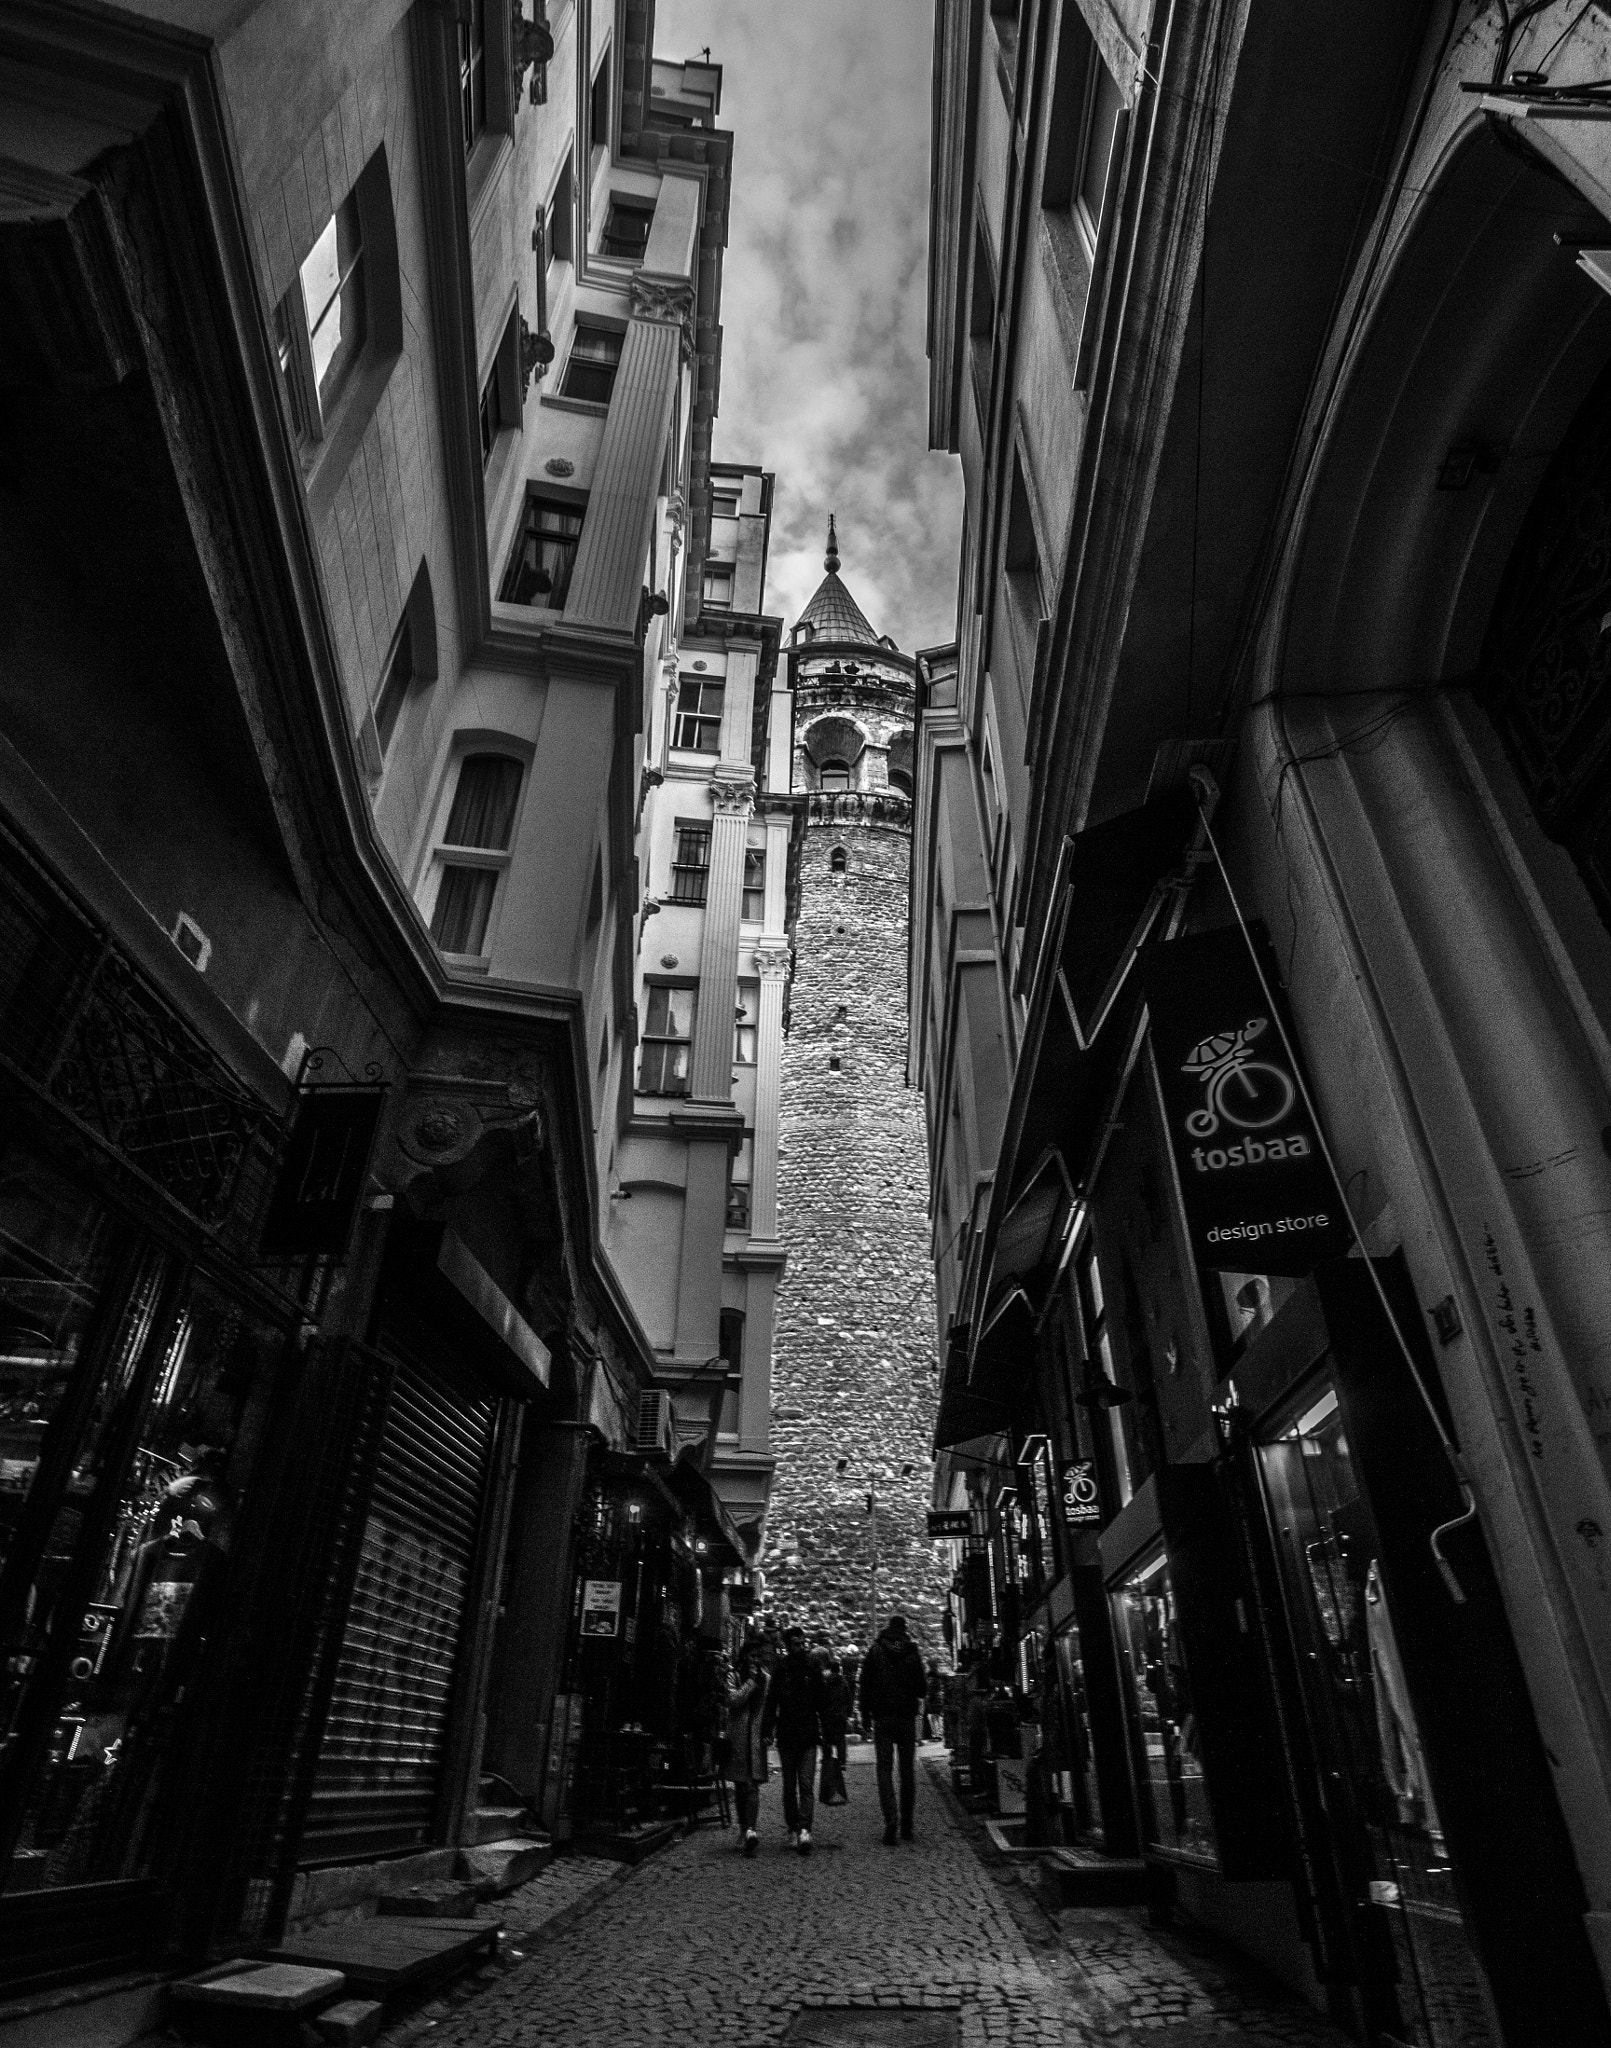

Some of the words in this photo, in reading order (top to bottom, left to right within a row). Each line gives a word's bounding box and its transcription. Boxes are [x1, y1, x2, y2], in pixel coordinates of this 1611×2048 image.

[1191, 1135, 1310, 1172] tosbaa
[1206, 1221, 1274, 1243] design
[1275, 1214, 1329, 1234] store
